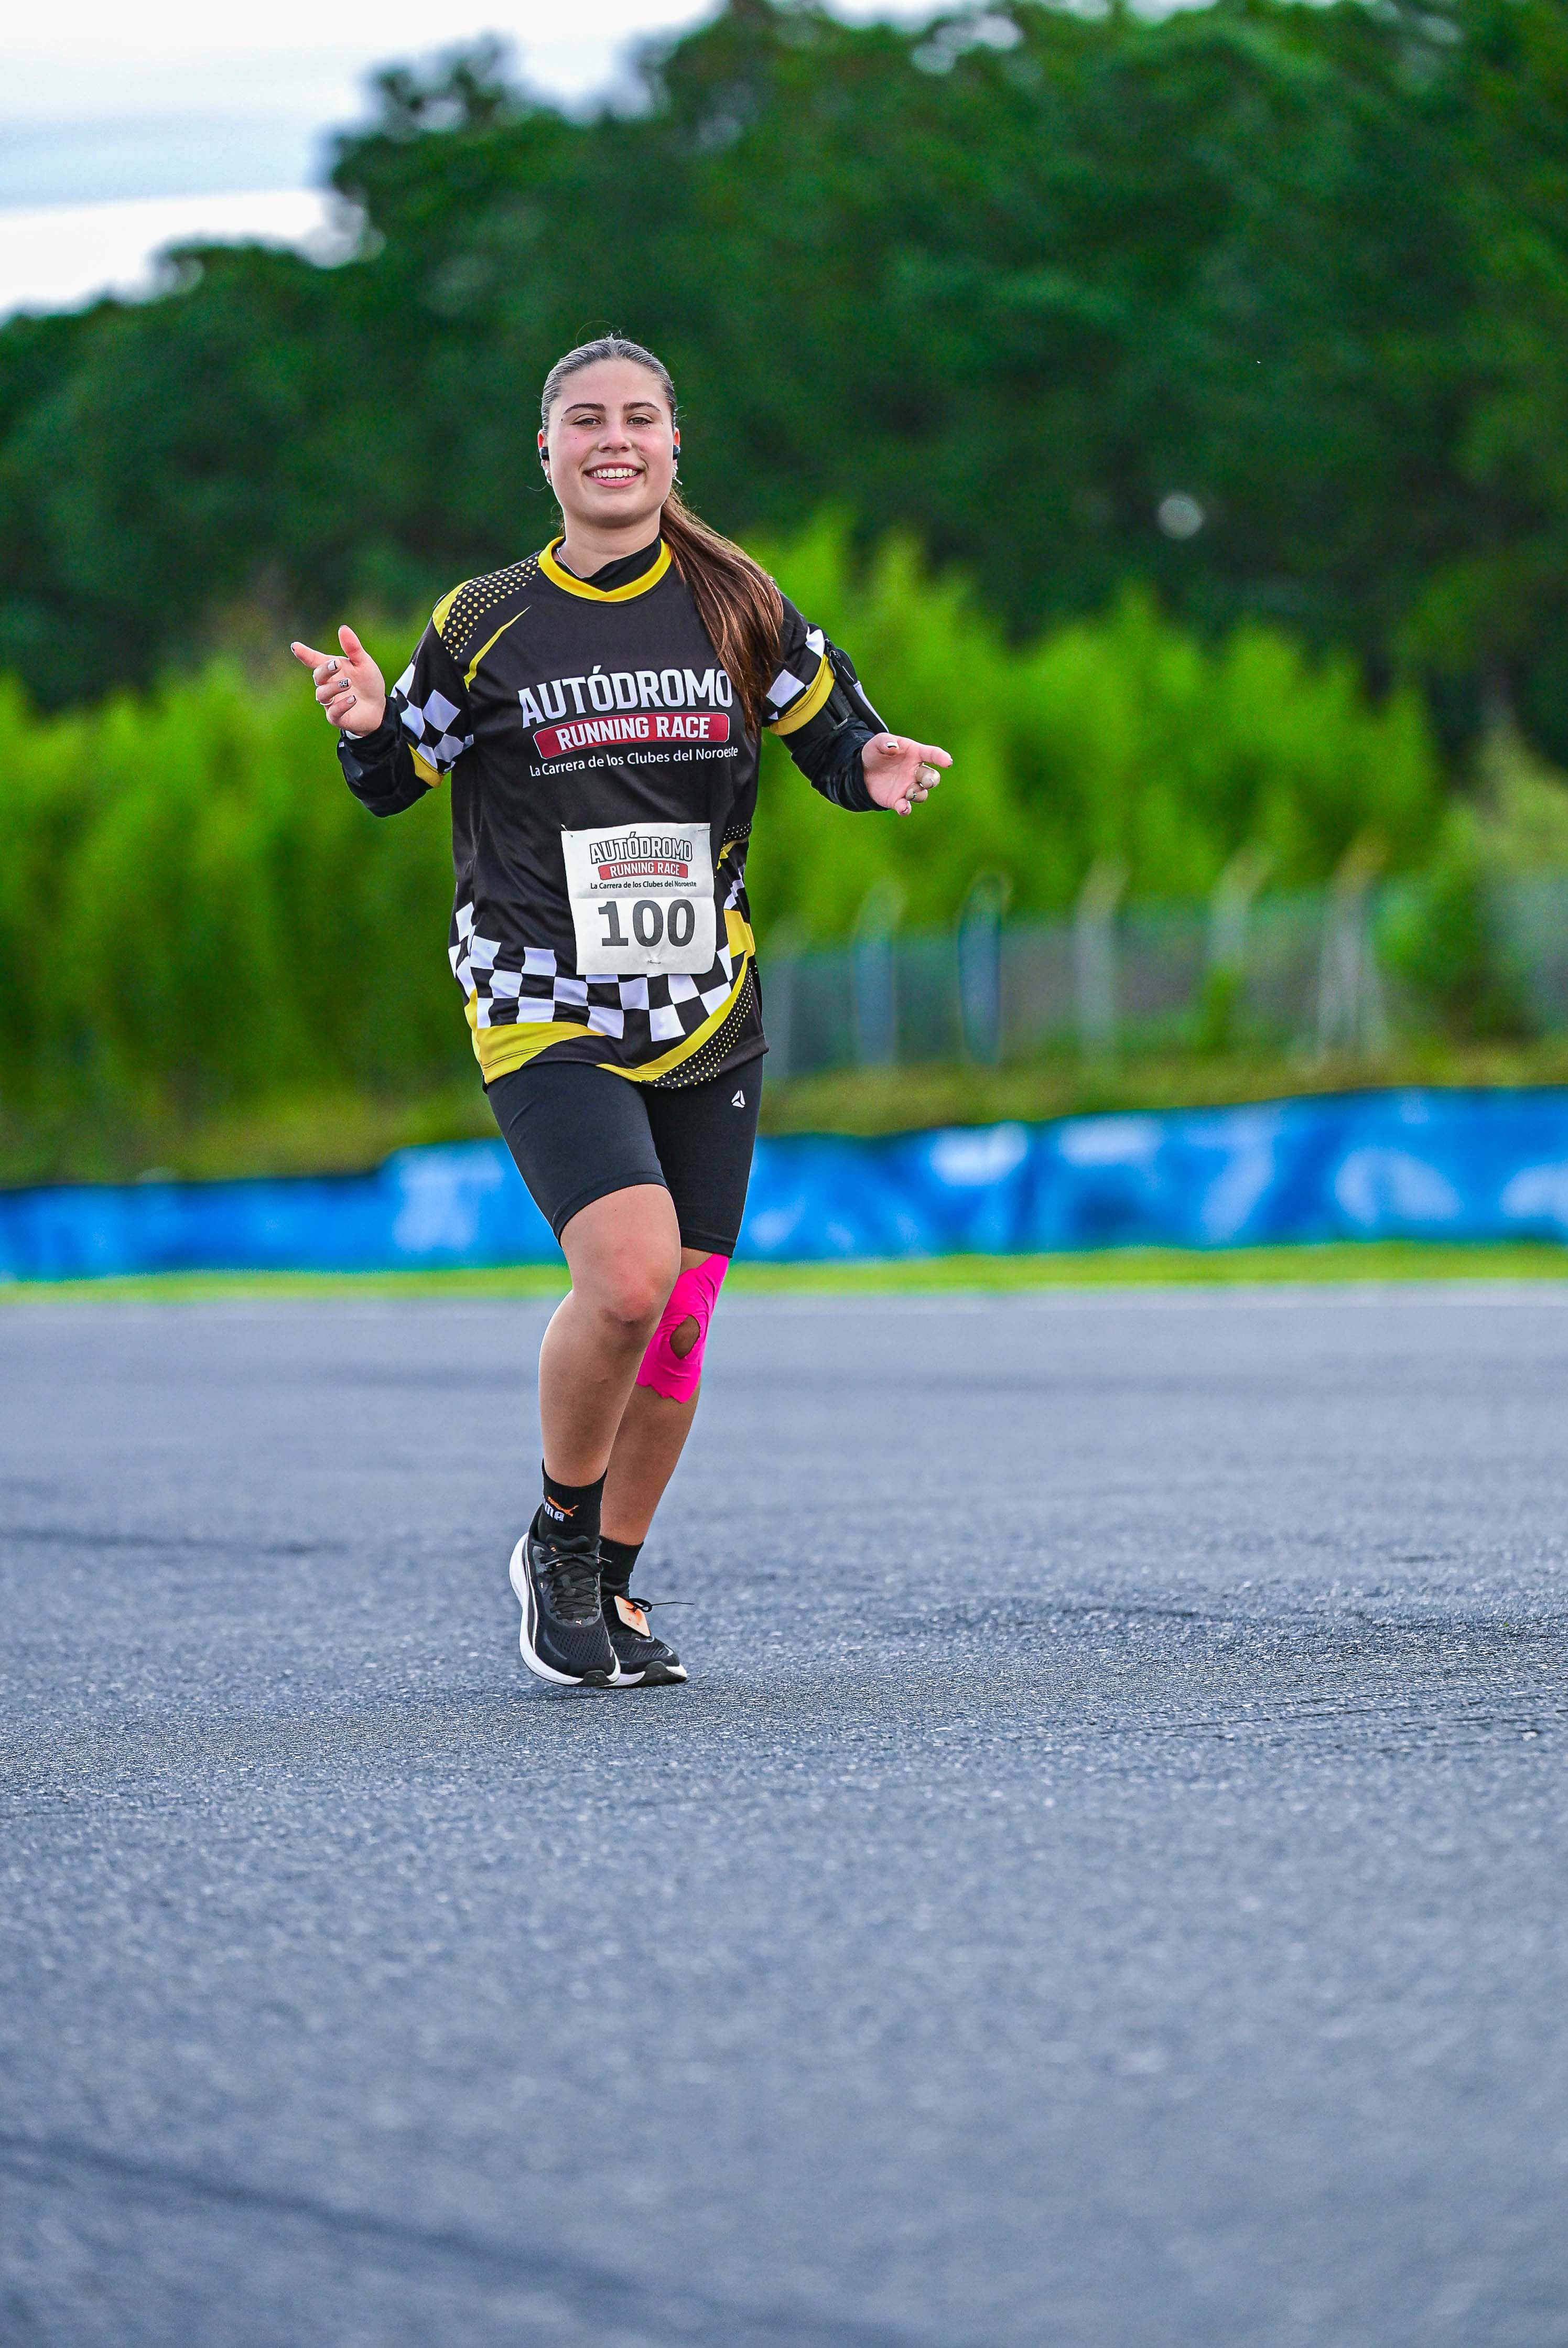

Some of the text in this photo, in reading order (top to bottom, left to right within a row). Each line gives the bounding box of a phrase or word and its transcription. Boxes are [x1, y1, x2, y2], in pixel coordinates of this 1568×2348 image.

[517, 665, 733, 729] AUTÓDROMO
[555, 716, 711, 751] RUNNING RACE
[529, 746, 739, 777] La Carrera de los Clubes del Noroeste
[590, 831, 693, 864] AUTÓDROMO
[609, 861, 680, 878] RUNNING RACE
[598, 899, 695, 947] 100
